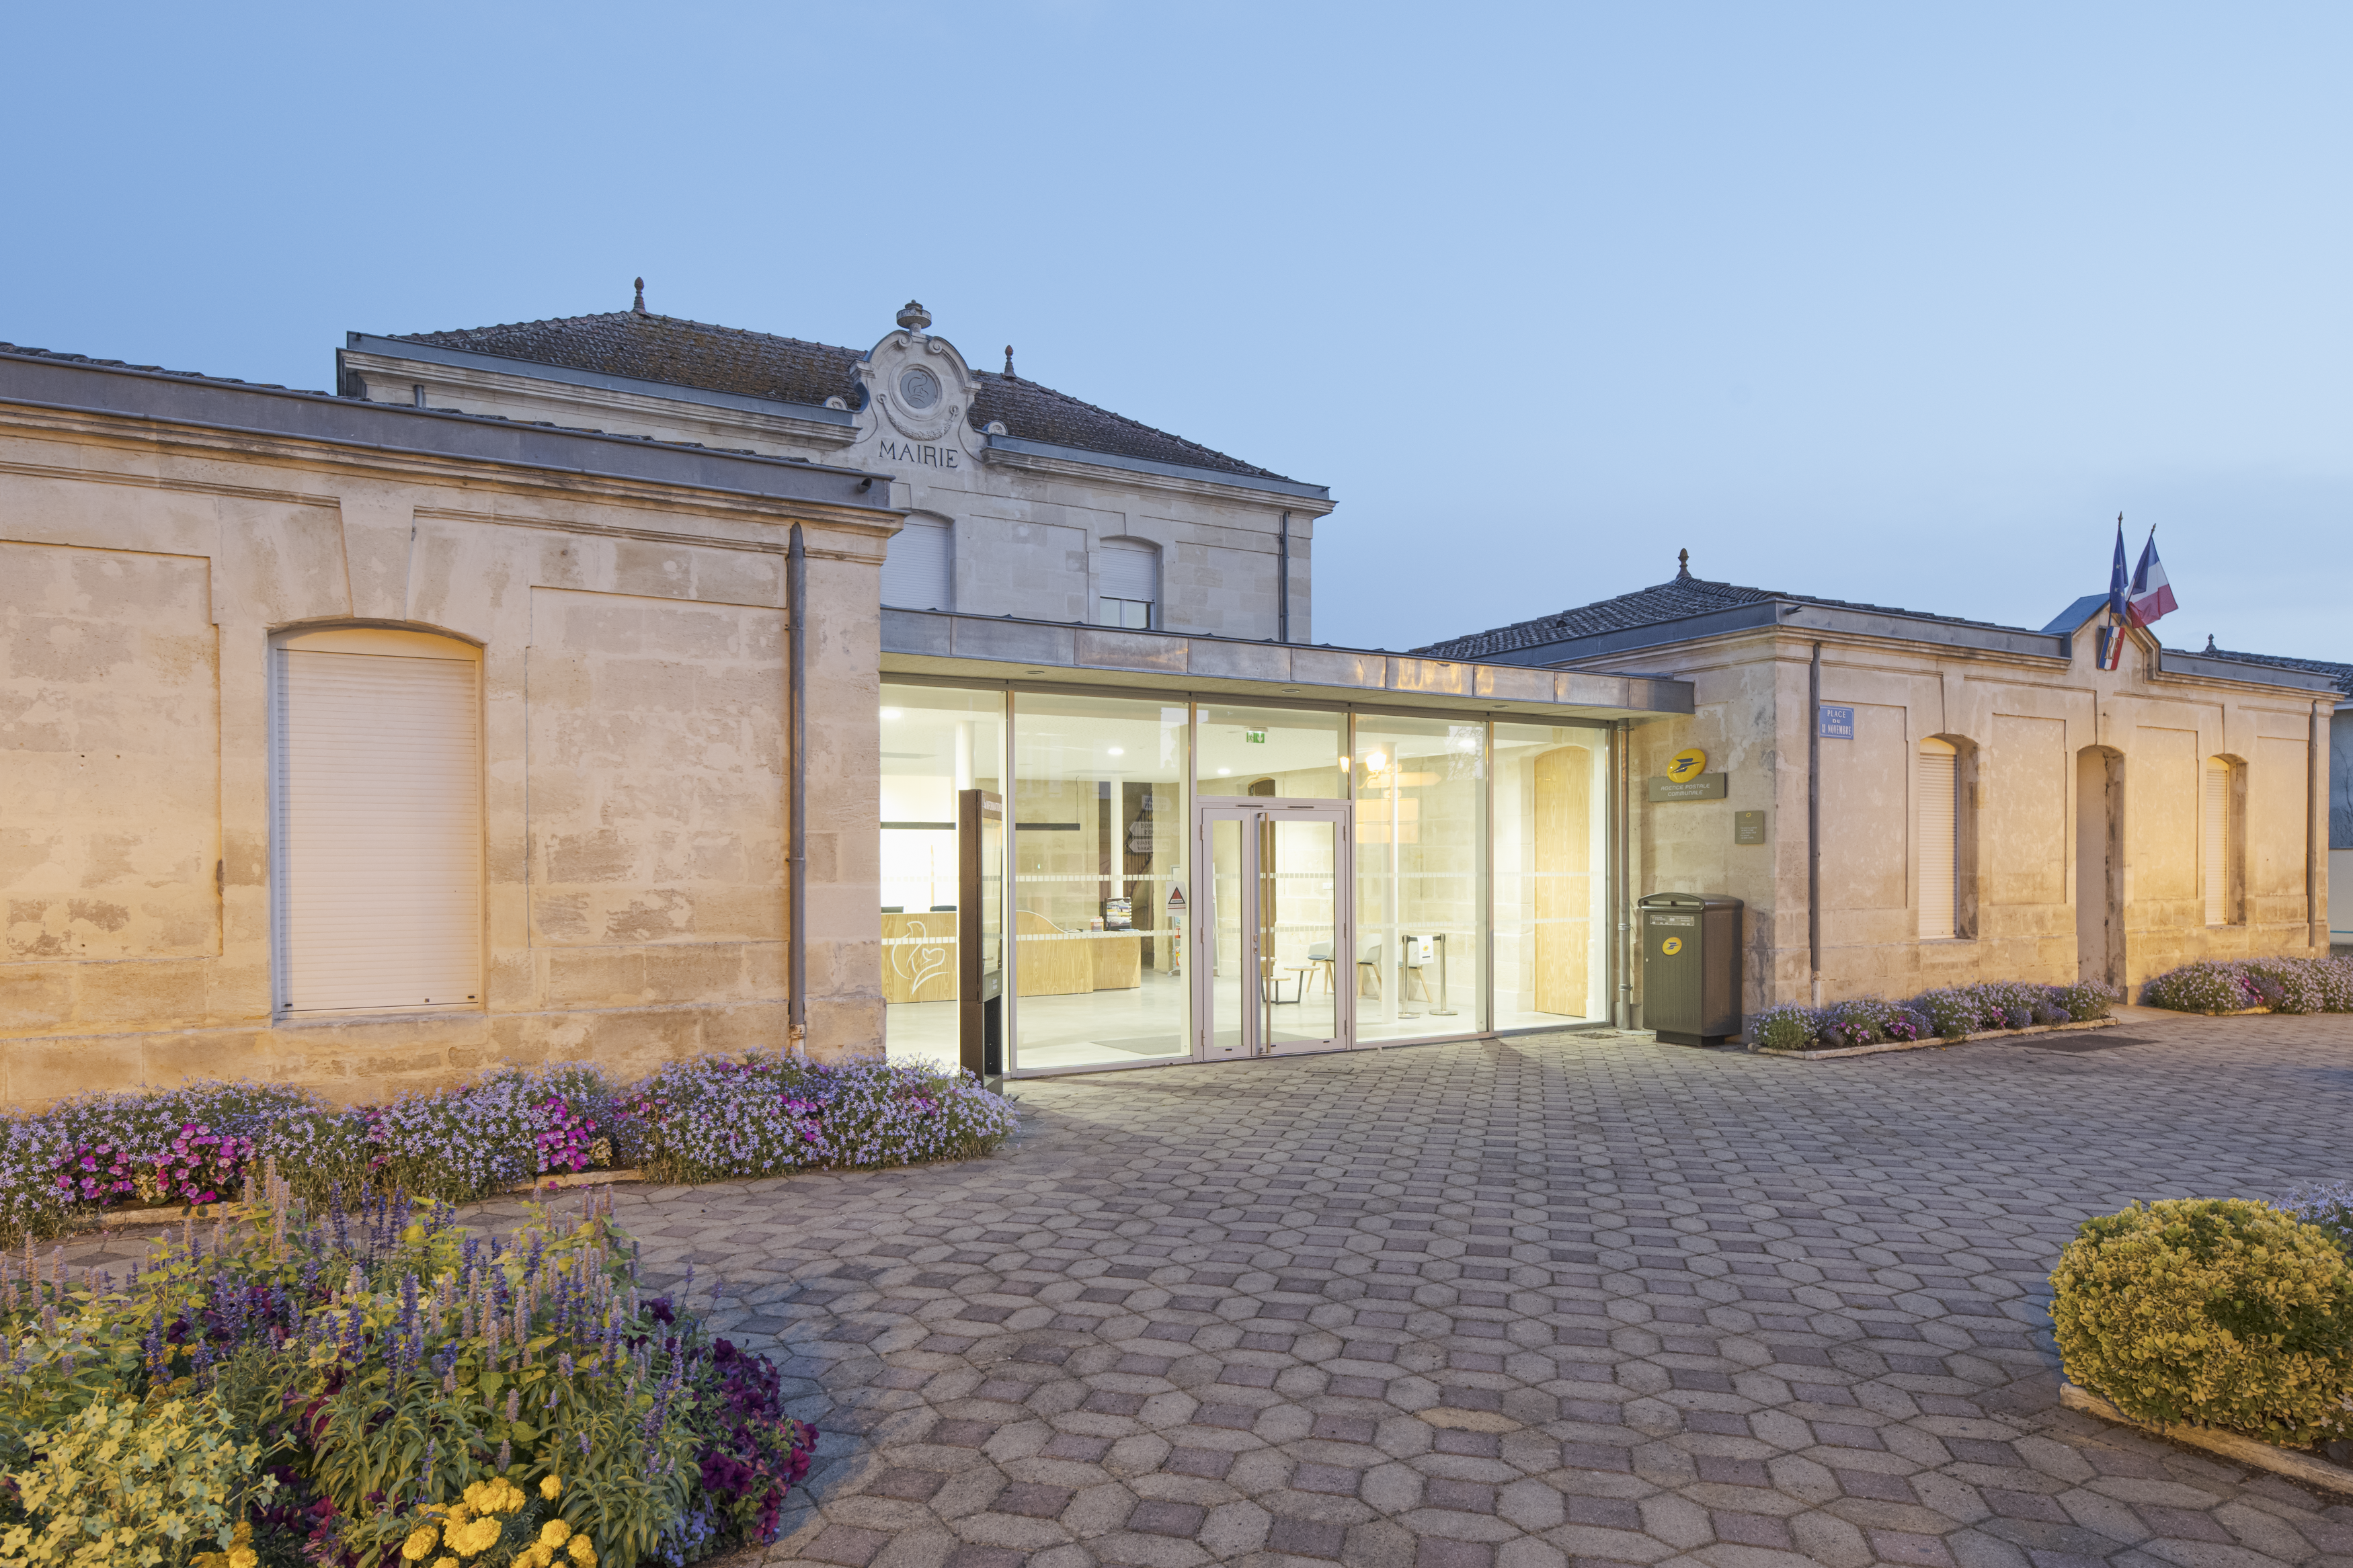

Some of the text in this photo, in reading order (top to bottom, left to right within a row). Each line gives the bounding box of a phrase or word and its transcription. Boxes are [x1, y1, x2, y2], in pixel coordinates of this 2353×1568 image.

[879, 440, 958, 468] MAIRIE
[2104, 636, 2121, 659] RF
[1827, 710, 1845, 718] PLACE
[1822, 724, 1851, 735] XI NOVEMBRE
